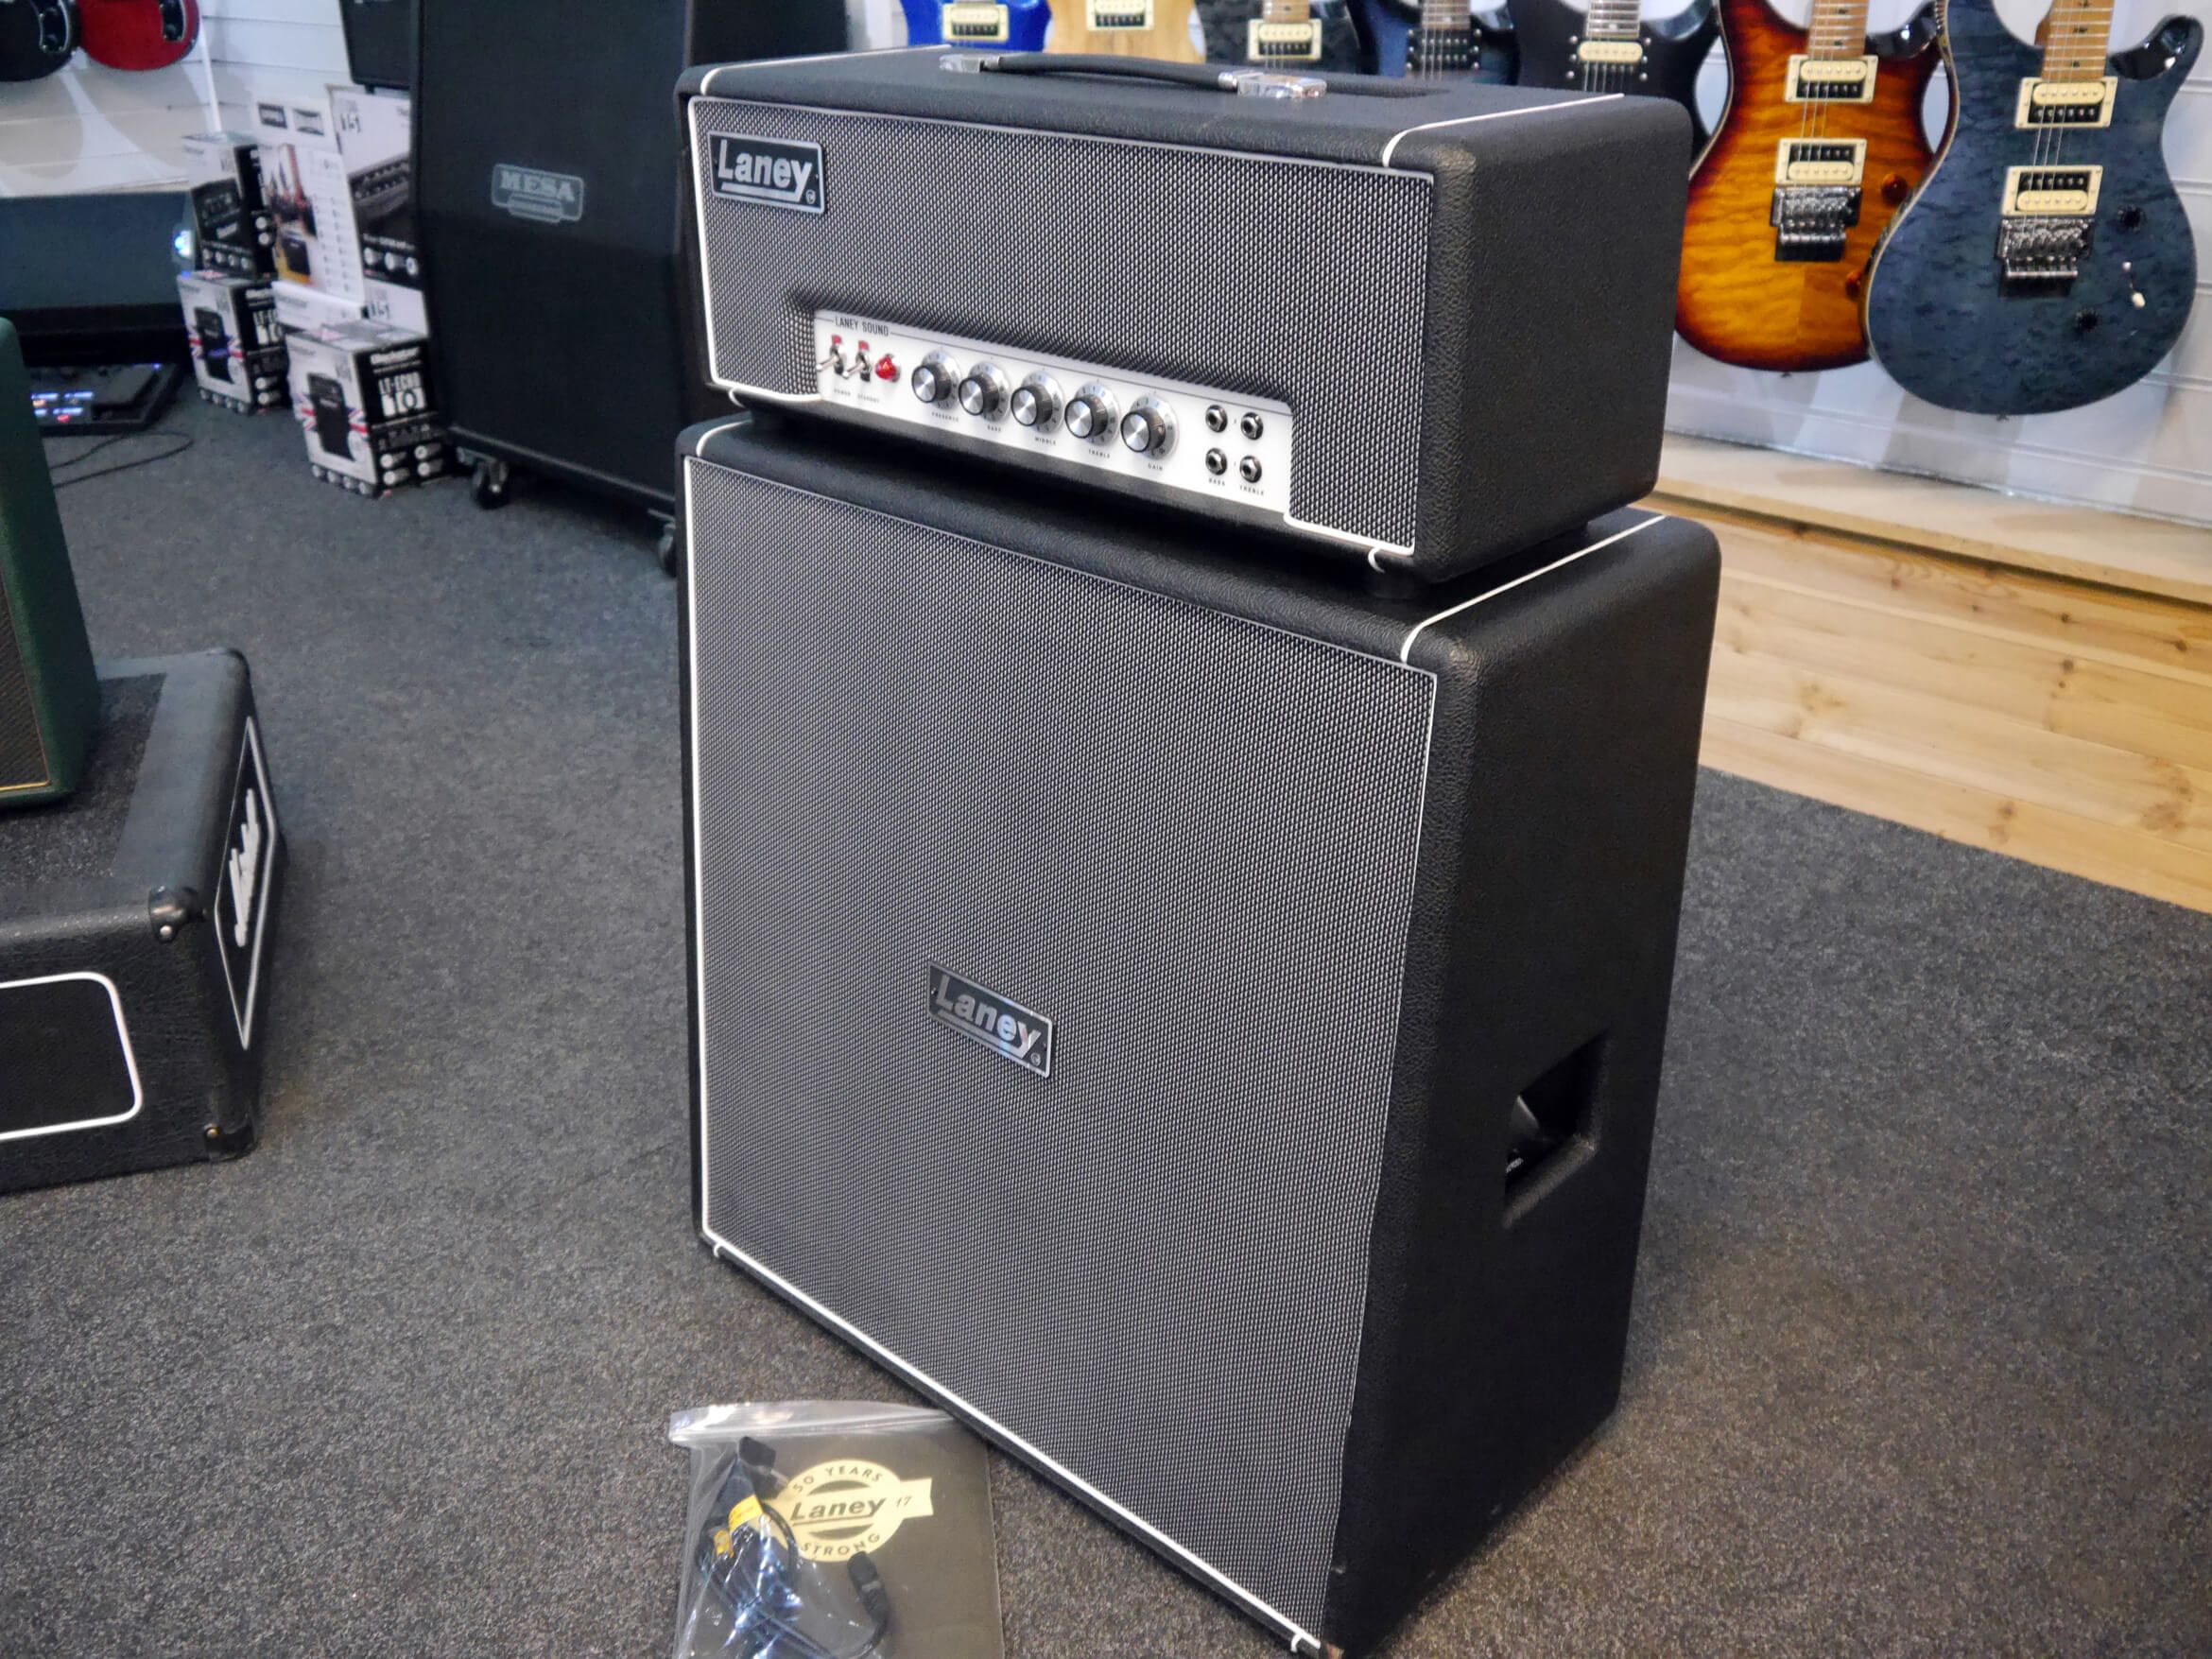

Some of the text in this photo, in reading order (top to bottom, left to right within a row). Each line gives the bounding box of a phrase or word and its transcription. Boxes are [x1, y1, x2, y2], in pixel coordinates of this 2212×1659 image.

[718, 139, 813, 202] Laney
[499, 170, 575, 203] MESA
[835, 316, 890, 337] LANEY SOUND
[1148, 463, 1164, 472] GAIN
[936, 975, 1042, 1059] Laney
[824, 1465, 883, 1483] YEARS
[790, 1497, 887, 1523] Laney
[801, 1532, 881, 1556] STRONG
